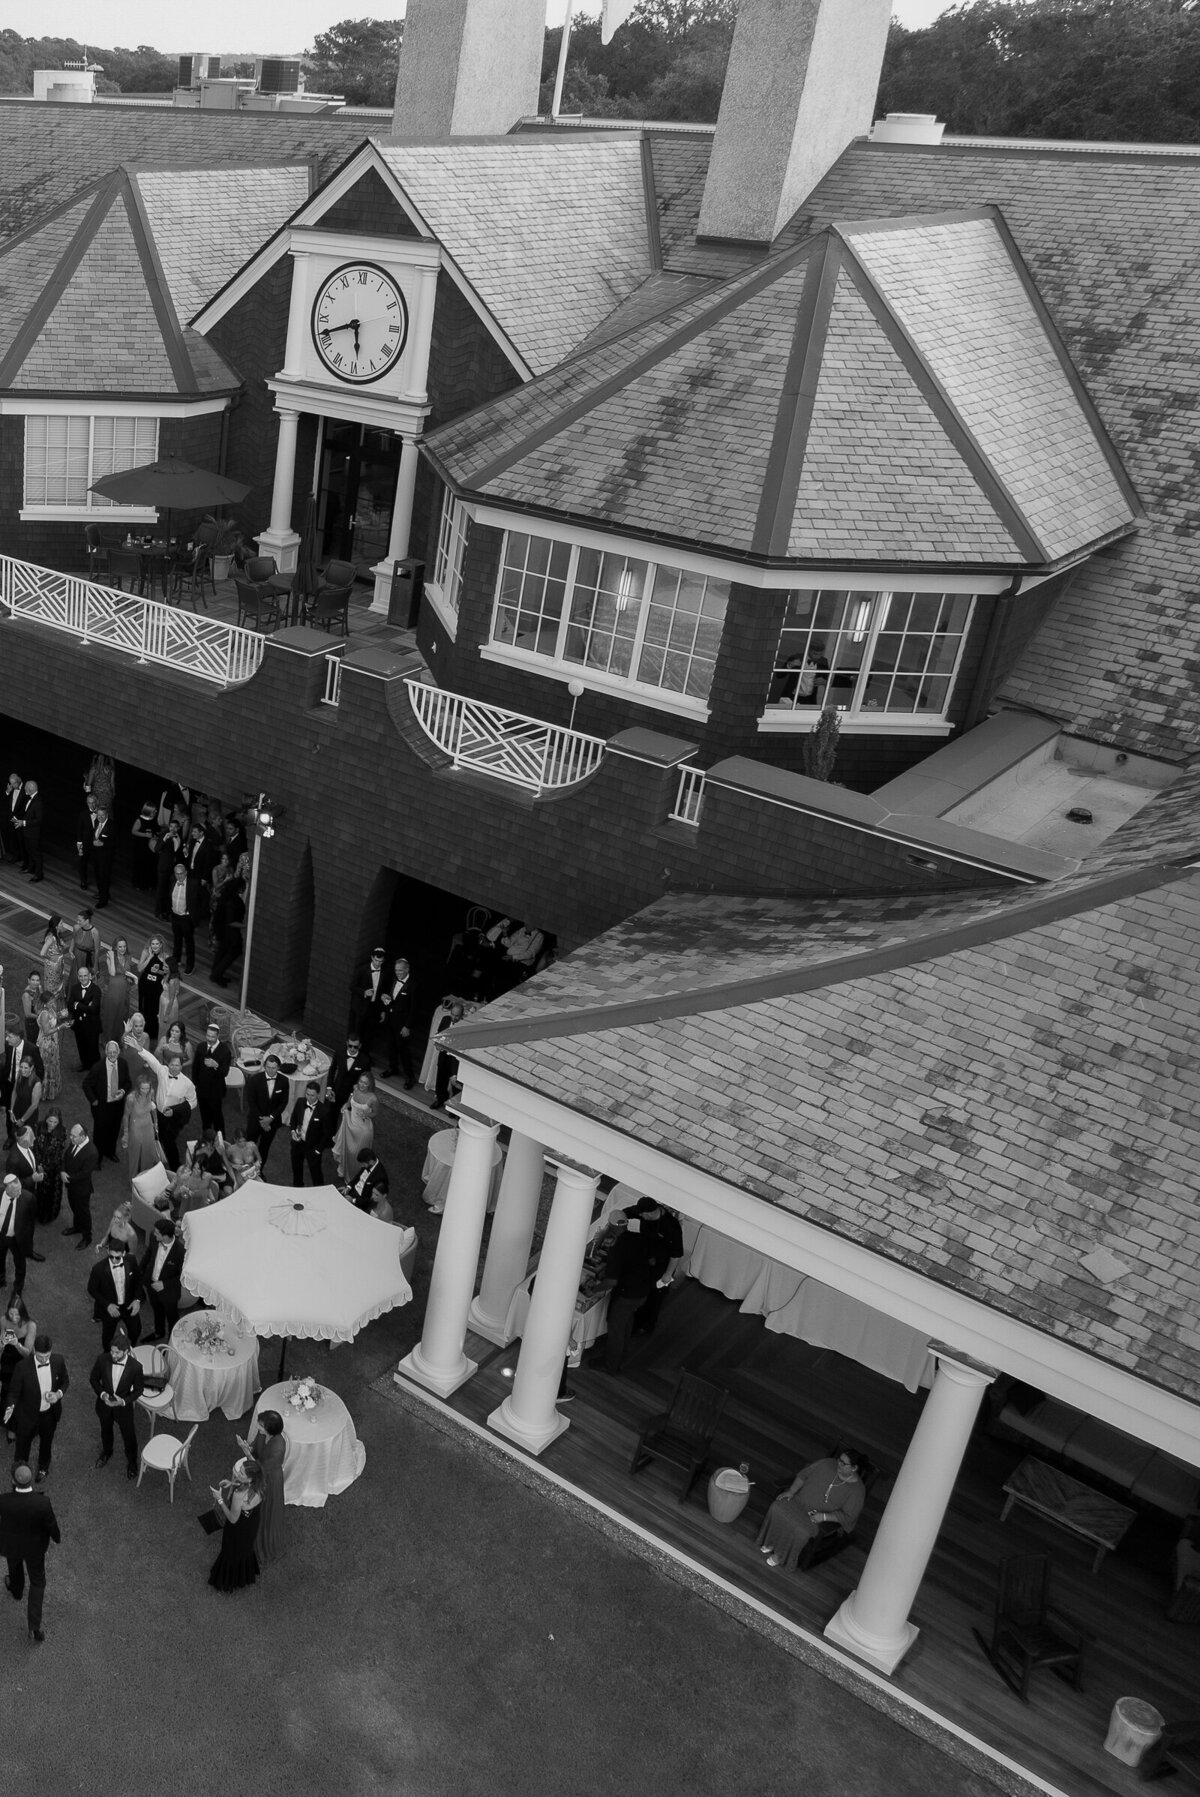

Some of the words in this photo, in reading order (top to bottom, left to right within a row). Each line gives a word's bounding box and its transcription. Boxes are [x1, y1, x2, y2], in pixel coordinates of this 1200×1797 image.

[340, 276, 350, 290] XI
[357, 272, 368, 285] XII
[377, 282, 385, 293] I
[326, 292, 336, 303] X
[386, 301, 397, 311] II
[320, 314, 330, 324] IX
[389, 325, 400, 333] III
[381, 344, 393, 358] IIII
[333, 353, 343, 367] VII
[370, 360, 377, 372] V
[351, 361, 358, 375] VI
